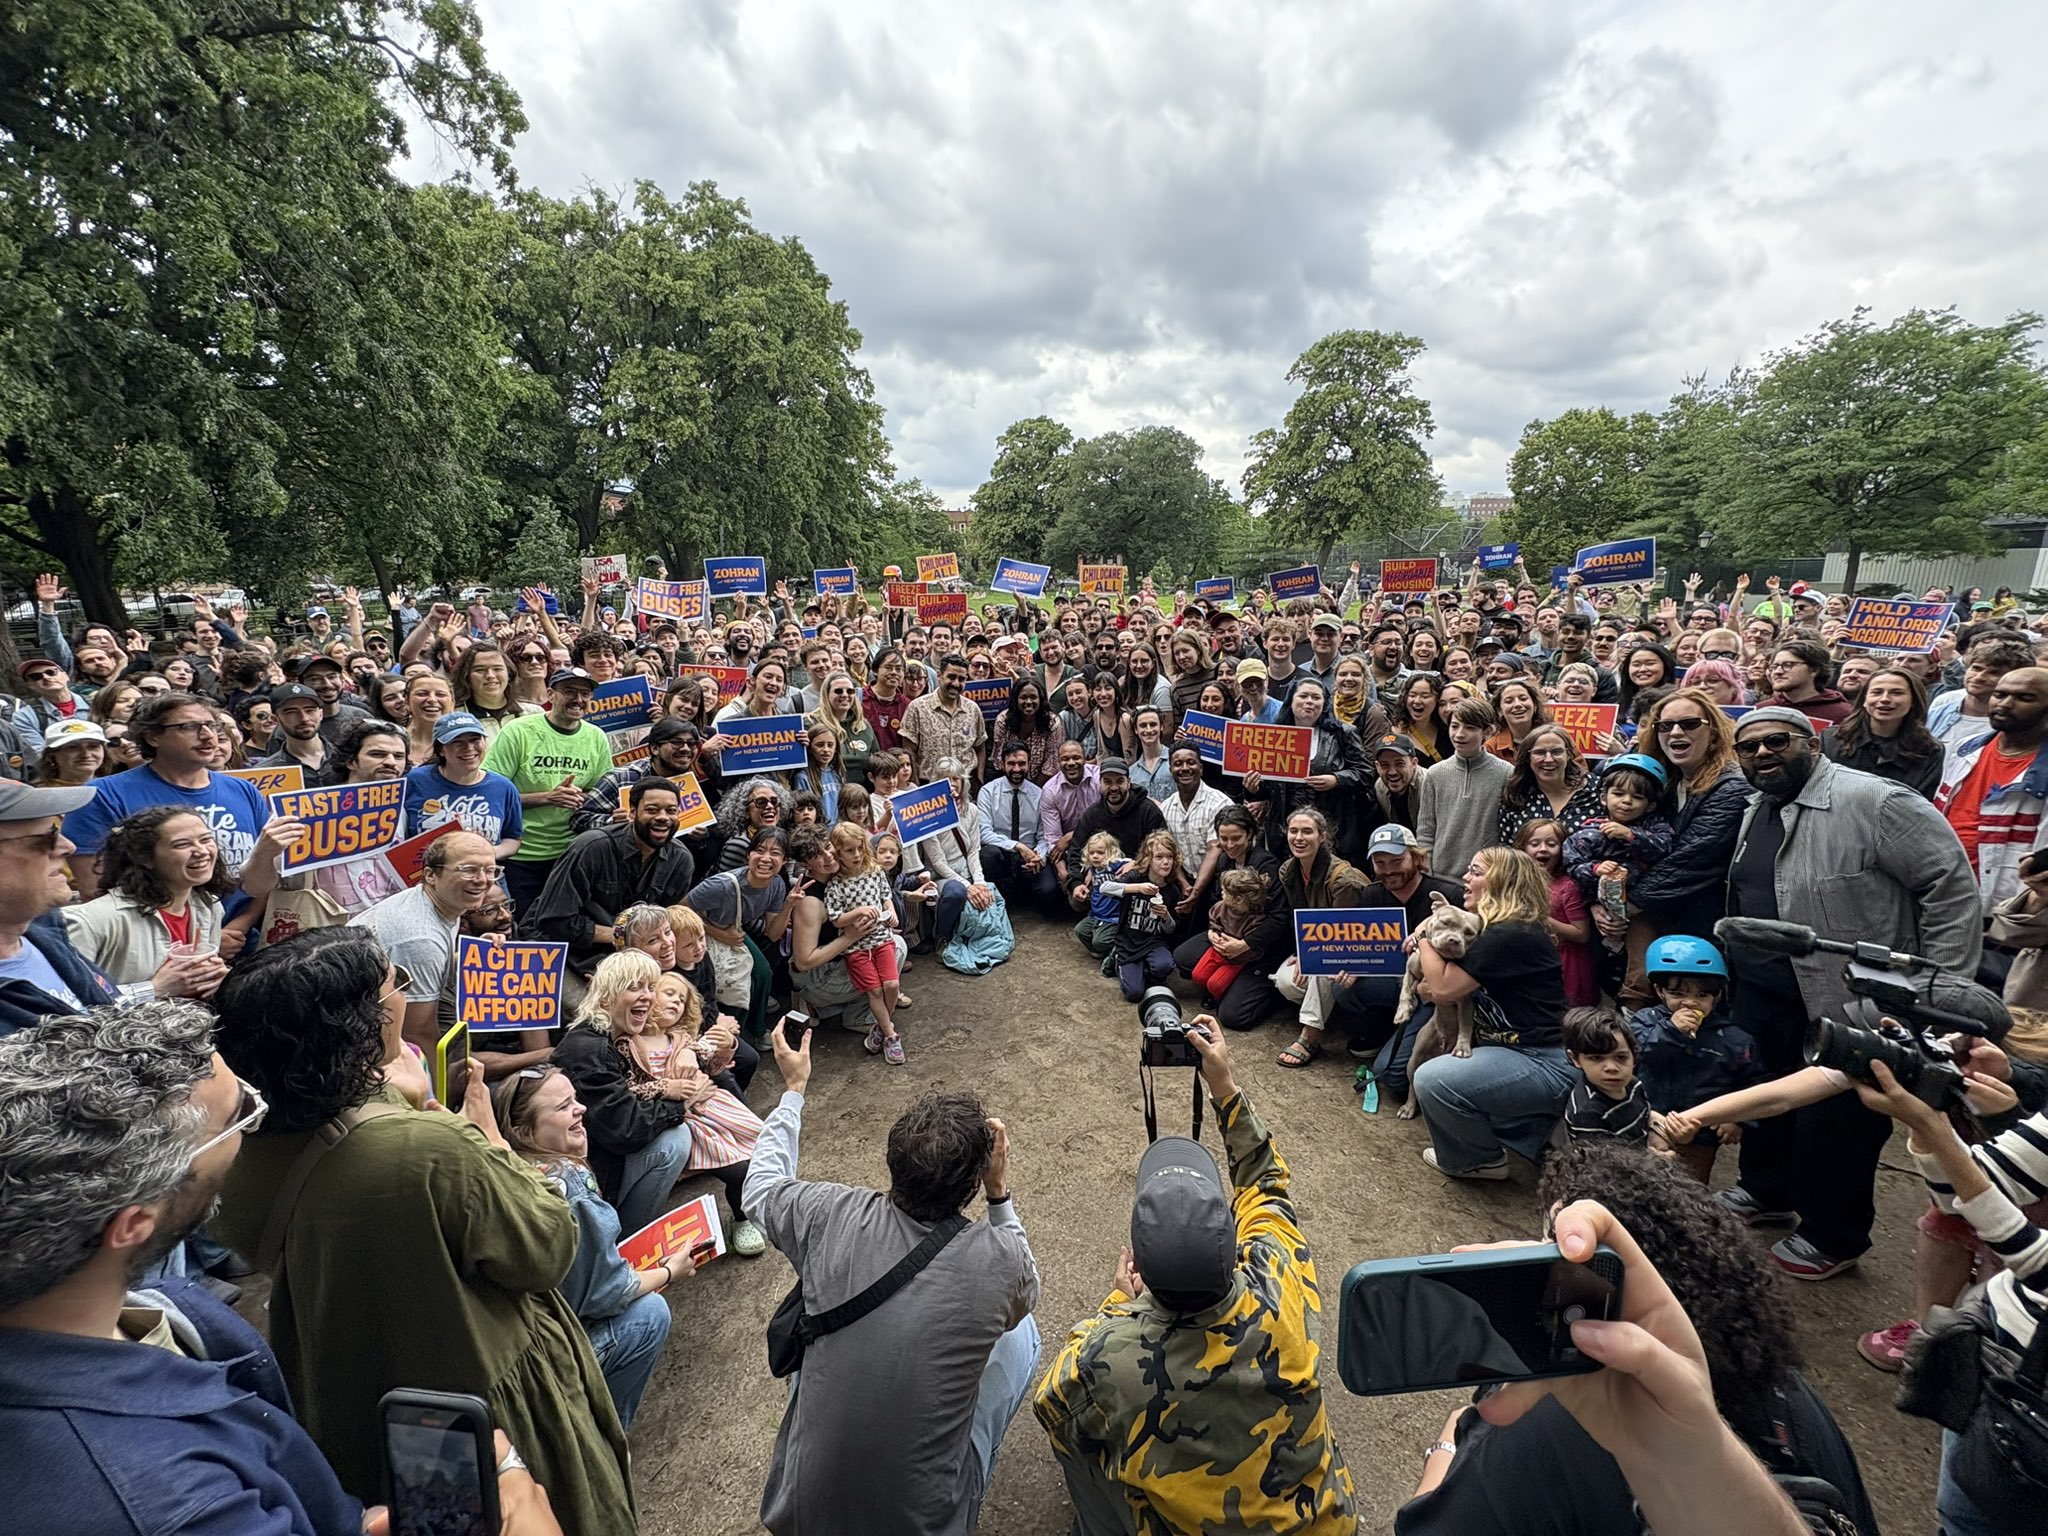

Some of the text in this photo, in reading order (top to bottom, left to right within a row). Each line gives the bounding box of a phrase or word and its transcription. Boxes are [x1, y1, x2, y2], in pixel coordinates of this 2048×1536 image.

[920, 556, 955, 573] CHILDCARE
[1384, 561, 1417, 572] BUILD
[1583, 550, 1646, 569] ZOHRAN
[599, 571, 621, 583] CLUB
[713, 567, 760, 579] ZOHRAN
[819, 575, 851, 584] ZOHRAN
[934, 566, 957, 580] ALL
[1003, 567, 1042, 583] ZOHRAN
[1082, 568, 1121, 584] CHILDCARE
[1276, 574, 1315, 588] ZOHRAN
[642, 581, 704, 596] FAST & FREE
[891, 582, 921, 595] FREEZE
[1095, 580, 1120, 593] ALL
[1200, 584, 1230, 595] ZOHRAN
[1386, 577, 1433, 590] HOUSING
[642, 591, 703, 616] BUSES
[920, 595, 950, 607] BUILD
[1858, 602, 1946, 616] HOLD BAD
[1852, 613, 1943, 633] LANDLORDS
[1850, 627, 1936, 649] ACCOUNTABLE
[962, 686, 1010, 701] OHRAN
[586, 691, 645, 714] OHRAN
[731, 729, 797, 748] ZOHRAN
[1186, 722, 1224, 742] ZOHRA
[1231, 726, 1298, 752] FREEZE
[533, 755, 590, 771] ZOHRAN
[1247, 749, 1305, 775] RENT
[281, 783, 402, 820] FAST & FREE
[438, 794, 491, 816] Vote
[899, 793, 949, 822] ZOHRAN
[288, 808, 398, 865] BUSES
[1301, 921, 1402, 942] ZOHRAN
[1374, 944, 1398, 952] CITY
[463, 943, 562, 971] A CITY
[463, 969, 557, 996] WE CAN
[462, 996, 556, 1022] AFFORD
